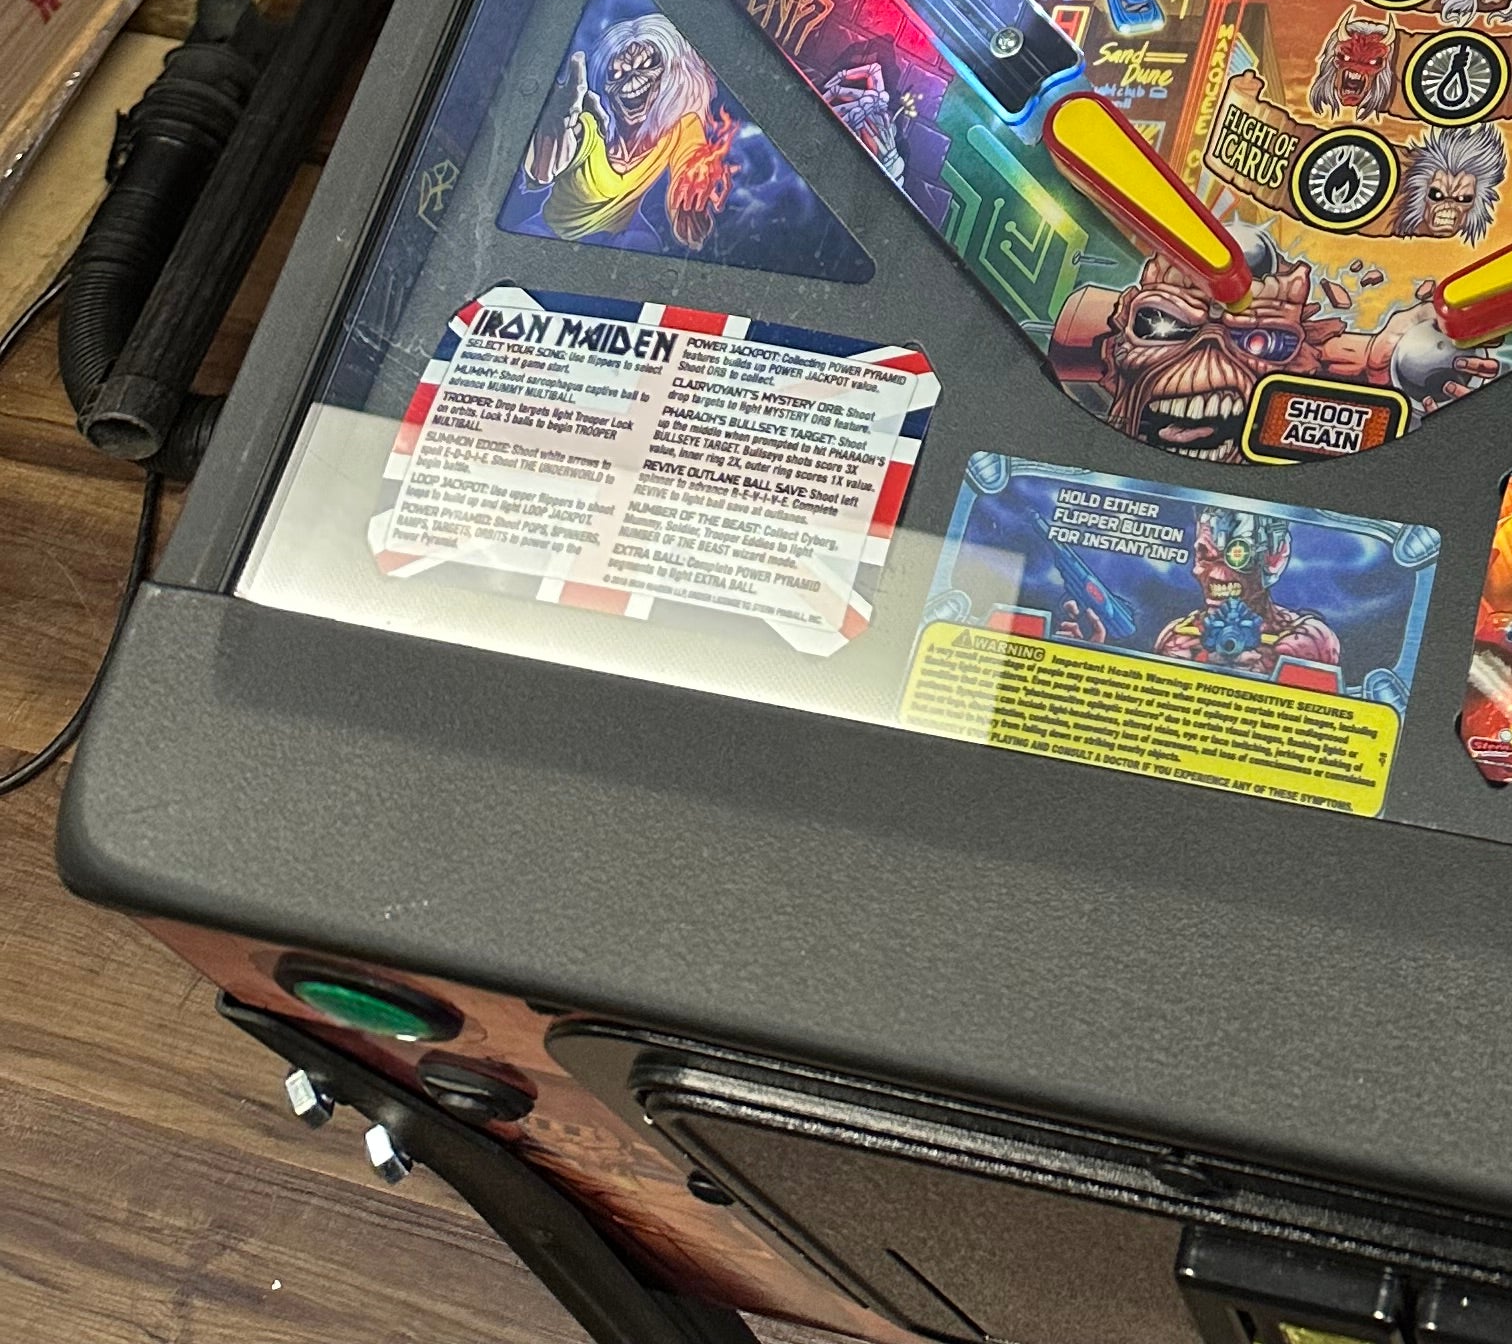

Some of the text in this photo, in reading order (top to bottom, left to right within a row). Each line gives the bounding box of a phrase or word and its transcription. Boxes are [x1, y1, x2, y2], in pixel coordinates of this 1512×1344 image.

[1093, 41, 1150, 66] Sand
[1120, 63, 1174, 88] Dune
[1195, 24, 1235, 135] MARQUEE
[1223, 104, 1299, 157] FLIGHT OF
[1212, 127, 1288, 188] ICARUS
[466, 337, 536, 356] SELECT YOUR
[472, 308, 679, 364] IRON MAIDEN
[687, 337, 907, 386] POWER JACKPOT: Collecting POWER PYRAMID
[769, 364, 850, 388] POWER JACKPOT
[761, 392, 816, 411] MYSTERY
[1287, 400, 1370, 429] SHOOT
[662, 406, 868, 451] PHARAOH'S BULLSEYE Shoot
[1281, 422, 1361, 451] AGAIN
[642, 459, 839, 504] REVIVE OUTLANE BALL Shoot
[1058, 488, 1160, 518] HOLD EITHER
[1053, 507, 1184, 543] FLIPPER BUTTON
[1048, 525, 1190, 565] FOR INSTANT INFO
[974, 634, 1045, 662] WARNING
[1196, 681, 1355, 721] PHOTOSENSITIVE SEIZURES
[1051, 742, 1094, 762] CONSULT
